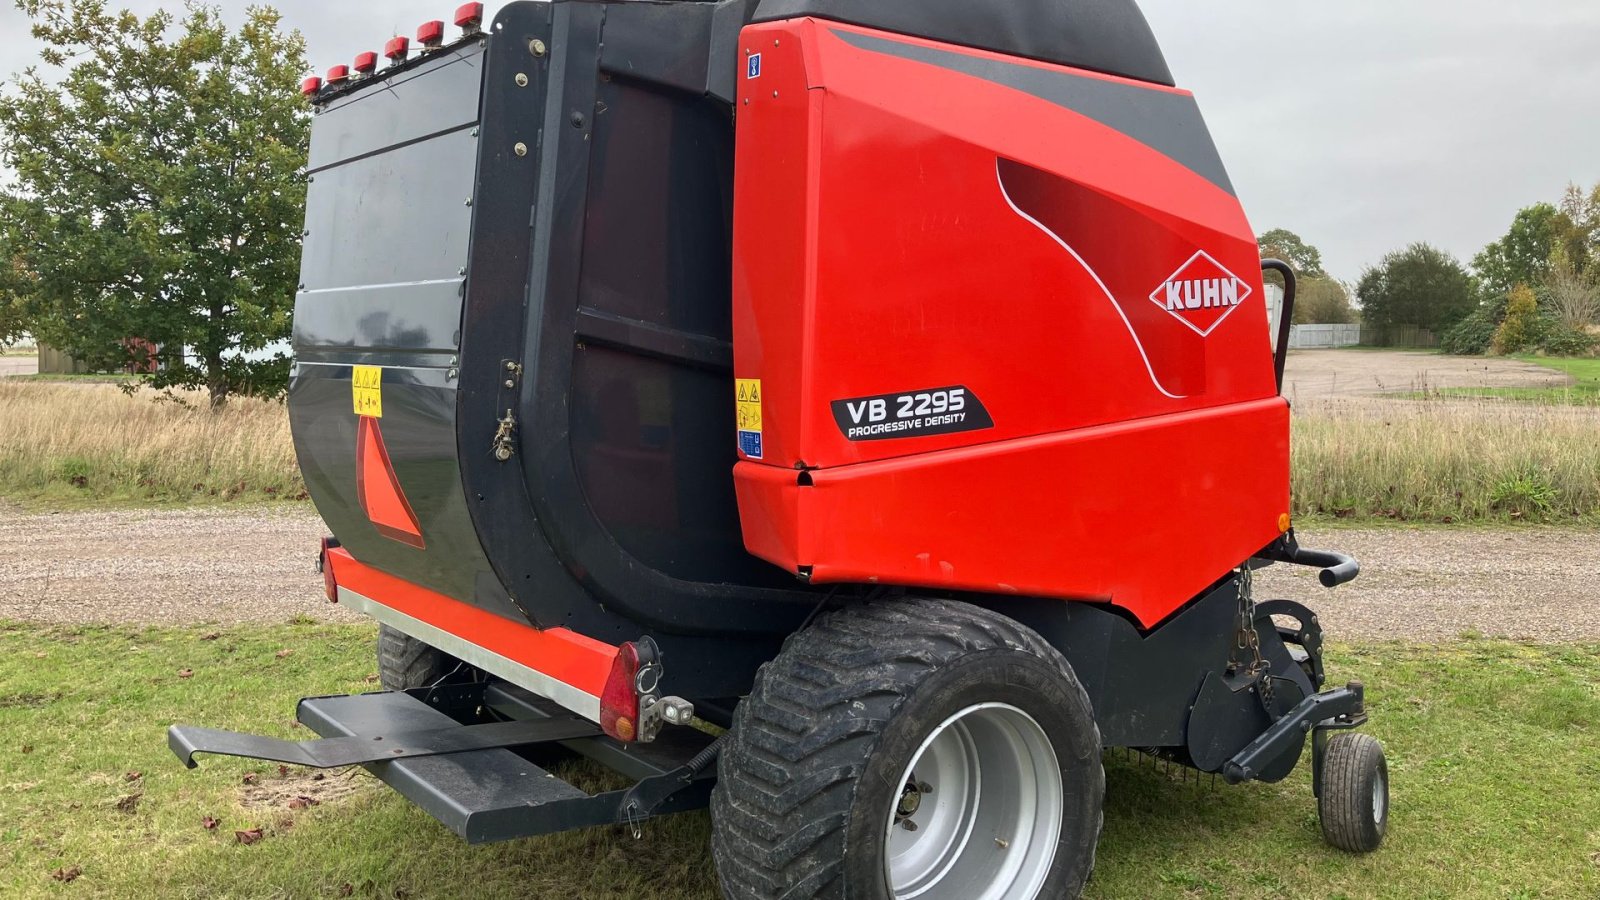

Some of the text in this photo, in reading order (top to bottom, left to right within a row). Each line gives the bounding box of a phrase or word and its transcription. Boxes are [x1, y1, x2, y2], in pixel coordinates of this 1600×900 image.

[1165, 277, 1238, 311] KUHN
[846, 388, 965, 424] VB 2295
[848, 412, 966, 437] PROGRESSIVE DENSITY
